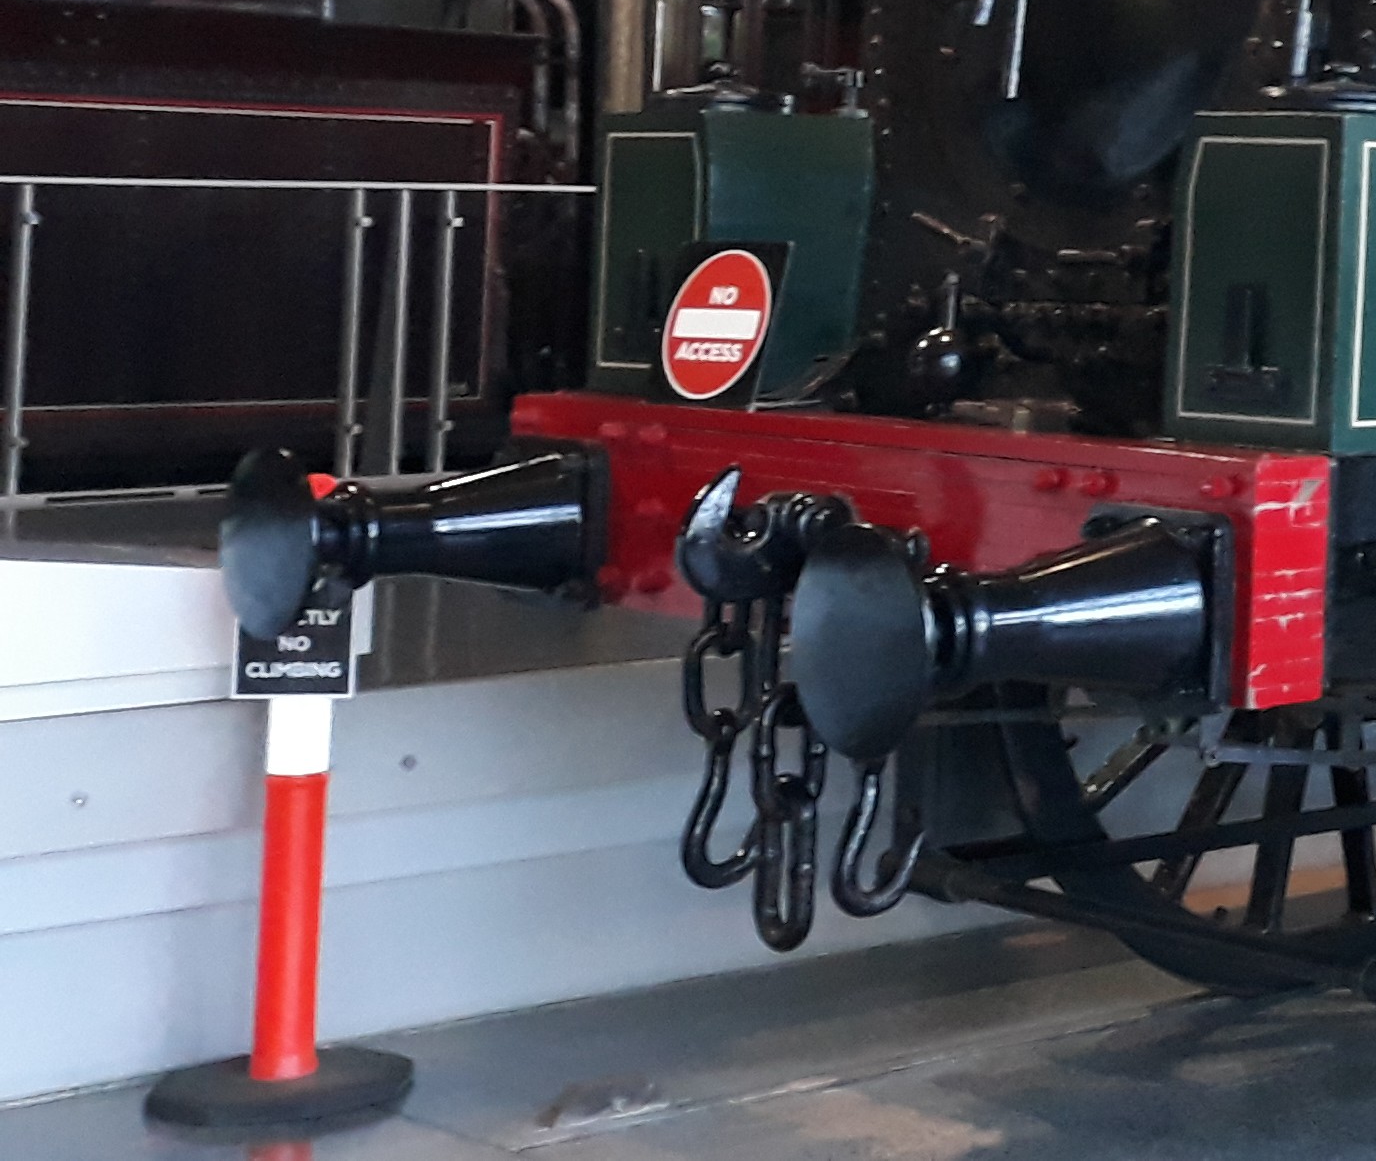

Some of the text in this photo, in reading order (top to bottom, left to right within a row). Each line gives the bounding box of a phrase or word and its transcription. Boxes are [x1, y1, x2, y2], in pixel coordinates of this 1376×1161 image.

[708, 285, 740, 305] NO
[674, 341, 744, 362] ACCESS
[277, 635, 311, 652] NO
[245, 661, 342, 678] CLIMBING
